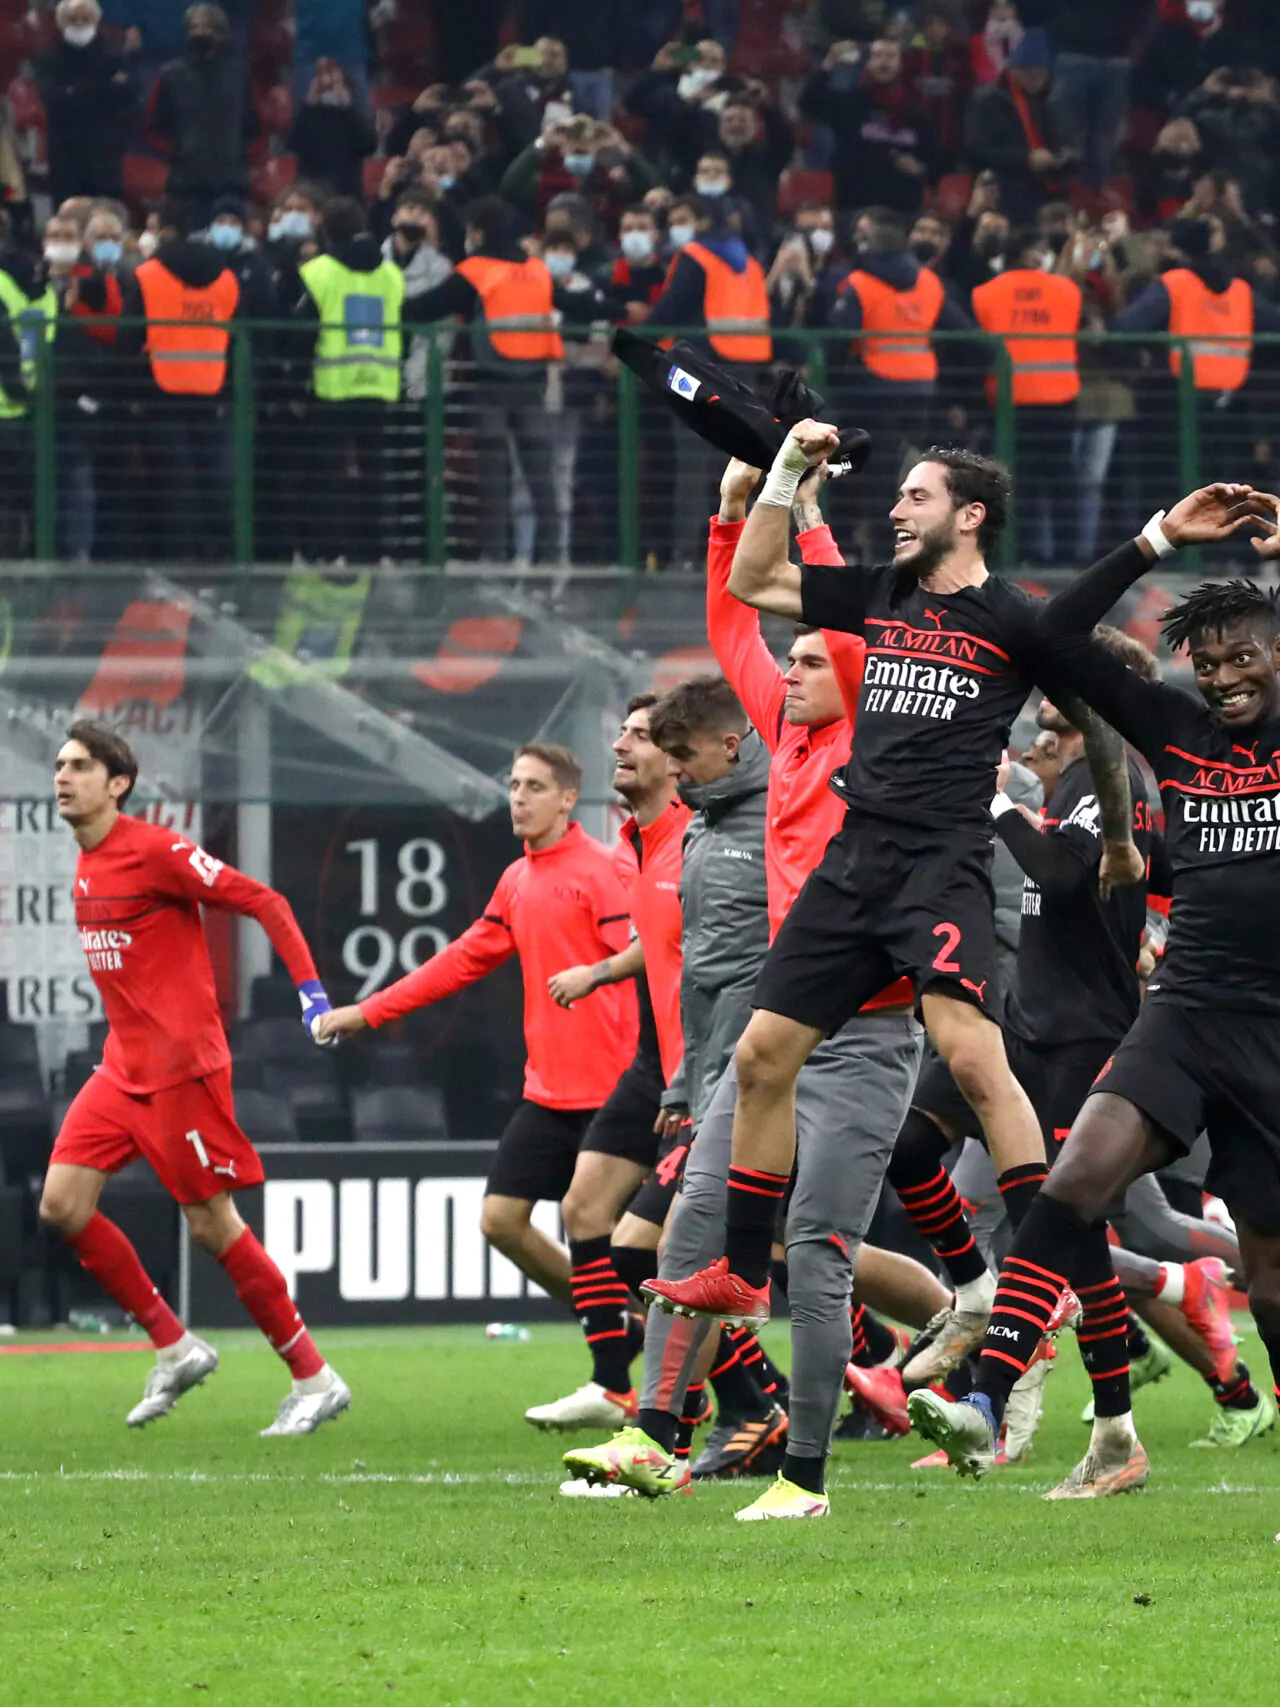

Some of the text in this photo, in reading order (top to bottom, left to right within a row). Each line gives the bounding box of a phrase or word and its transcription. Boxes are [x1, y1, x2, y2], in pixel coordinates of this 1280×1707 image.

[864, 656, 980, 698] Emirates
[865, 688, 957, 720] FLY BETTER
[1199, 827, 1227, 853] FLY
[345, 838, 447, 917] 18
[931, 922, 961, 972] 2
[186, 1129, 209, 1167] 1
[656, 1141, 694, 1186] 4
[986, 1325, 1020, 1341] ACM
